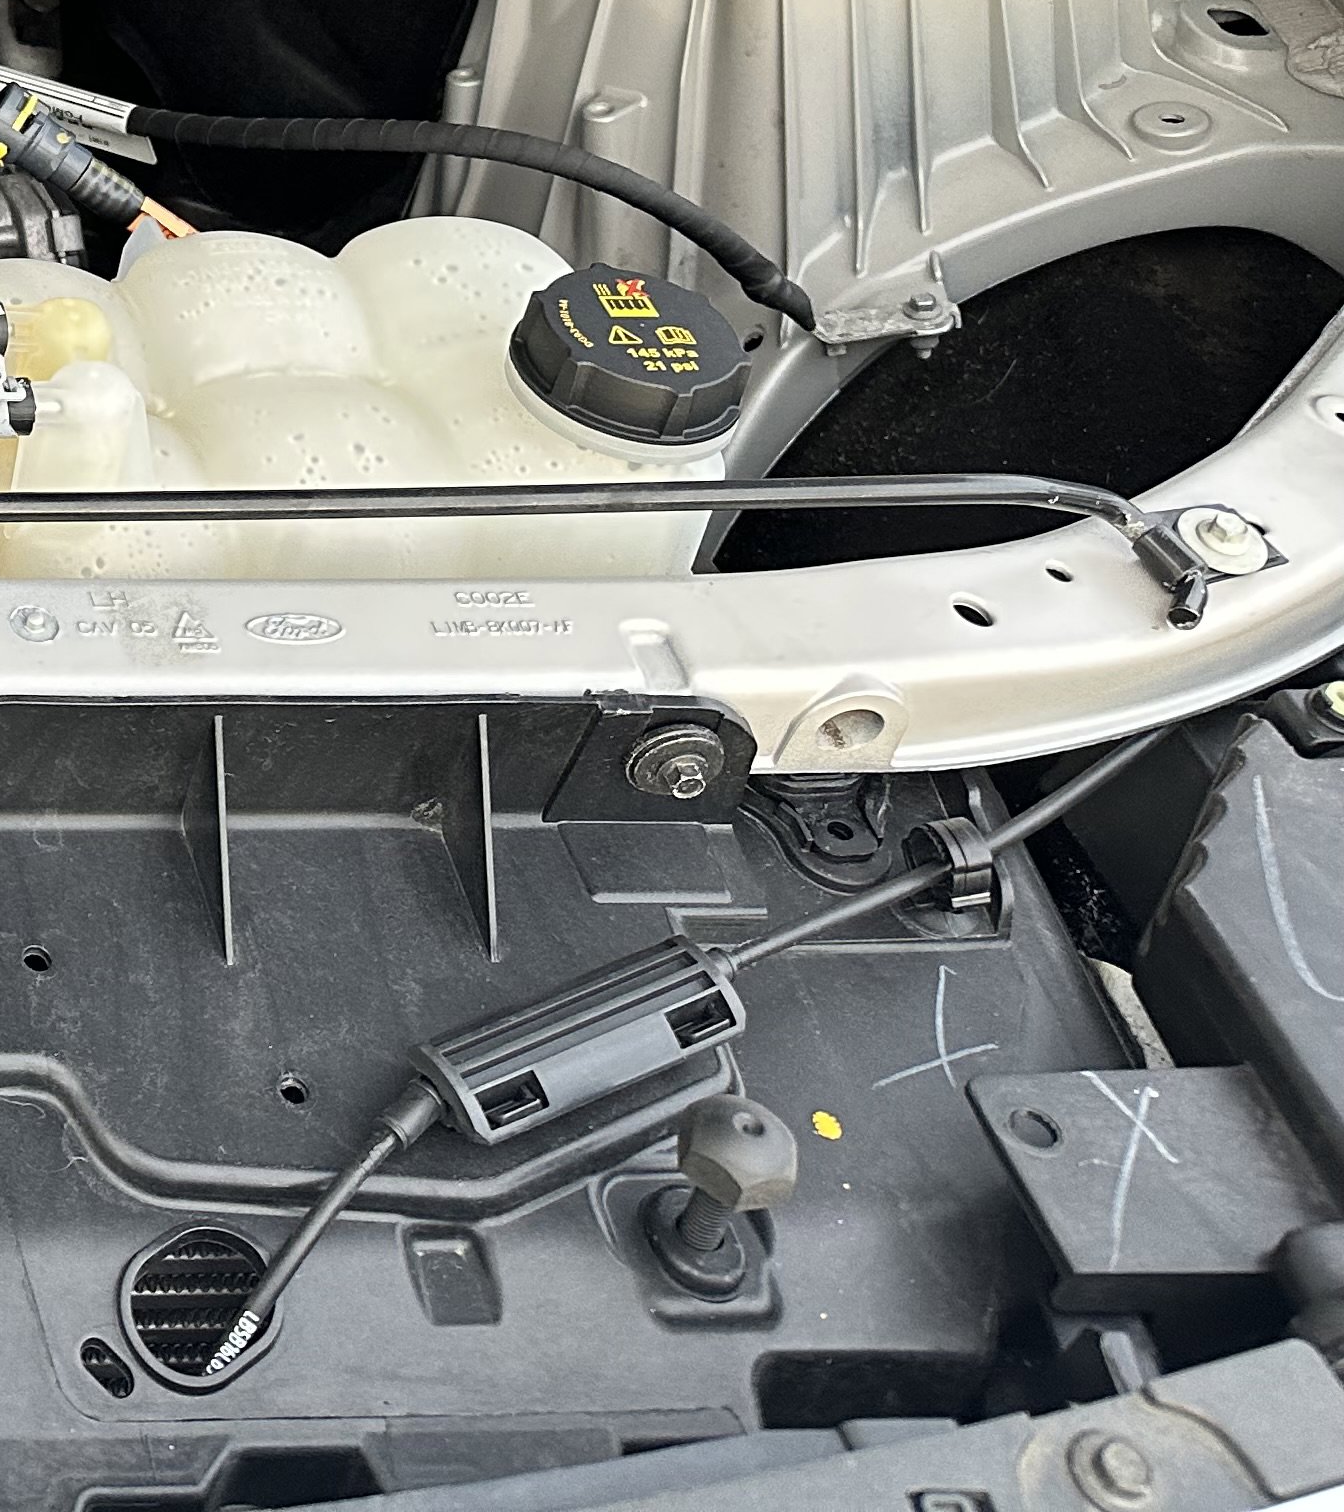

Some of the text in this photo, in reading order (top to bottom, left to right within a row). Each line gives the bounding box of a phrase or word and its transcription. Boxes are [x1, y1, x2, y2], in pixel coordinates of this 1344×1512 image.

[627, 347, 700, 358] 145 kPa
[643, 360, 700, 373] 21 psi
[87, 591, 130, 610] LH
